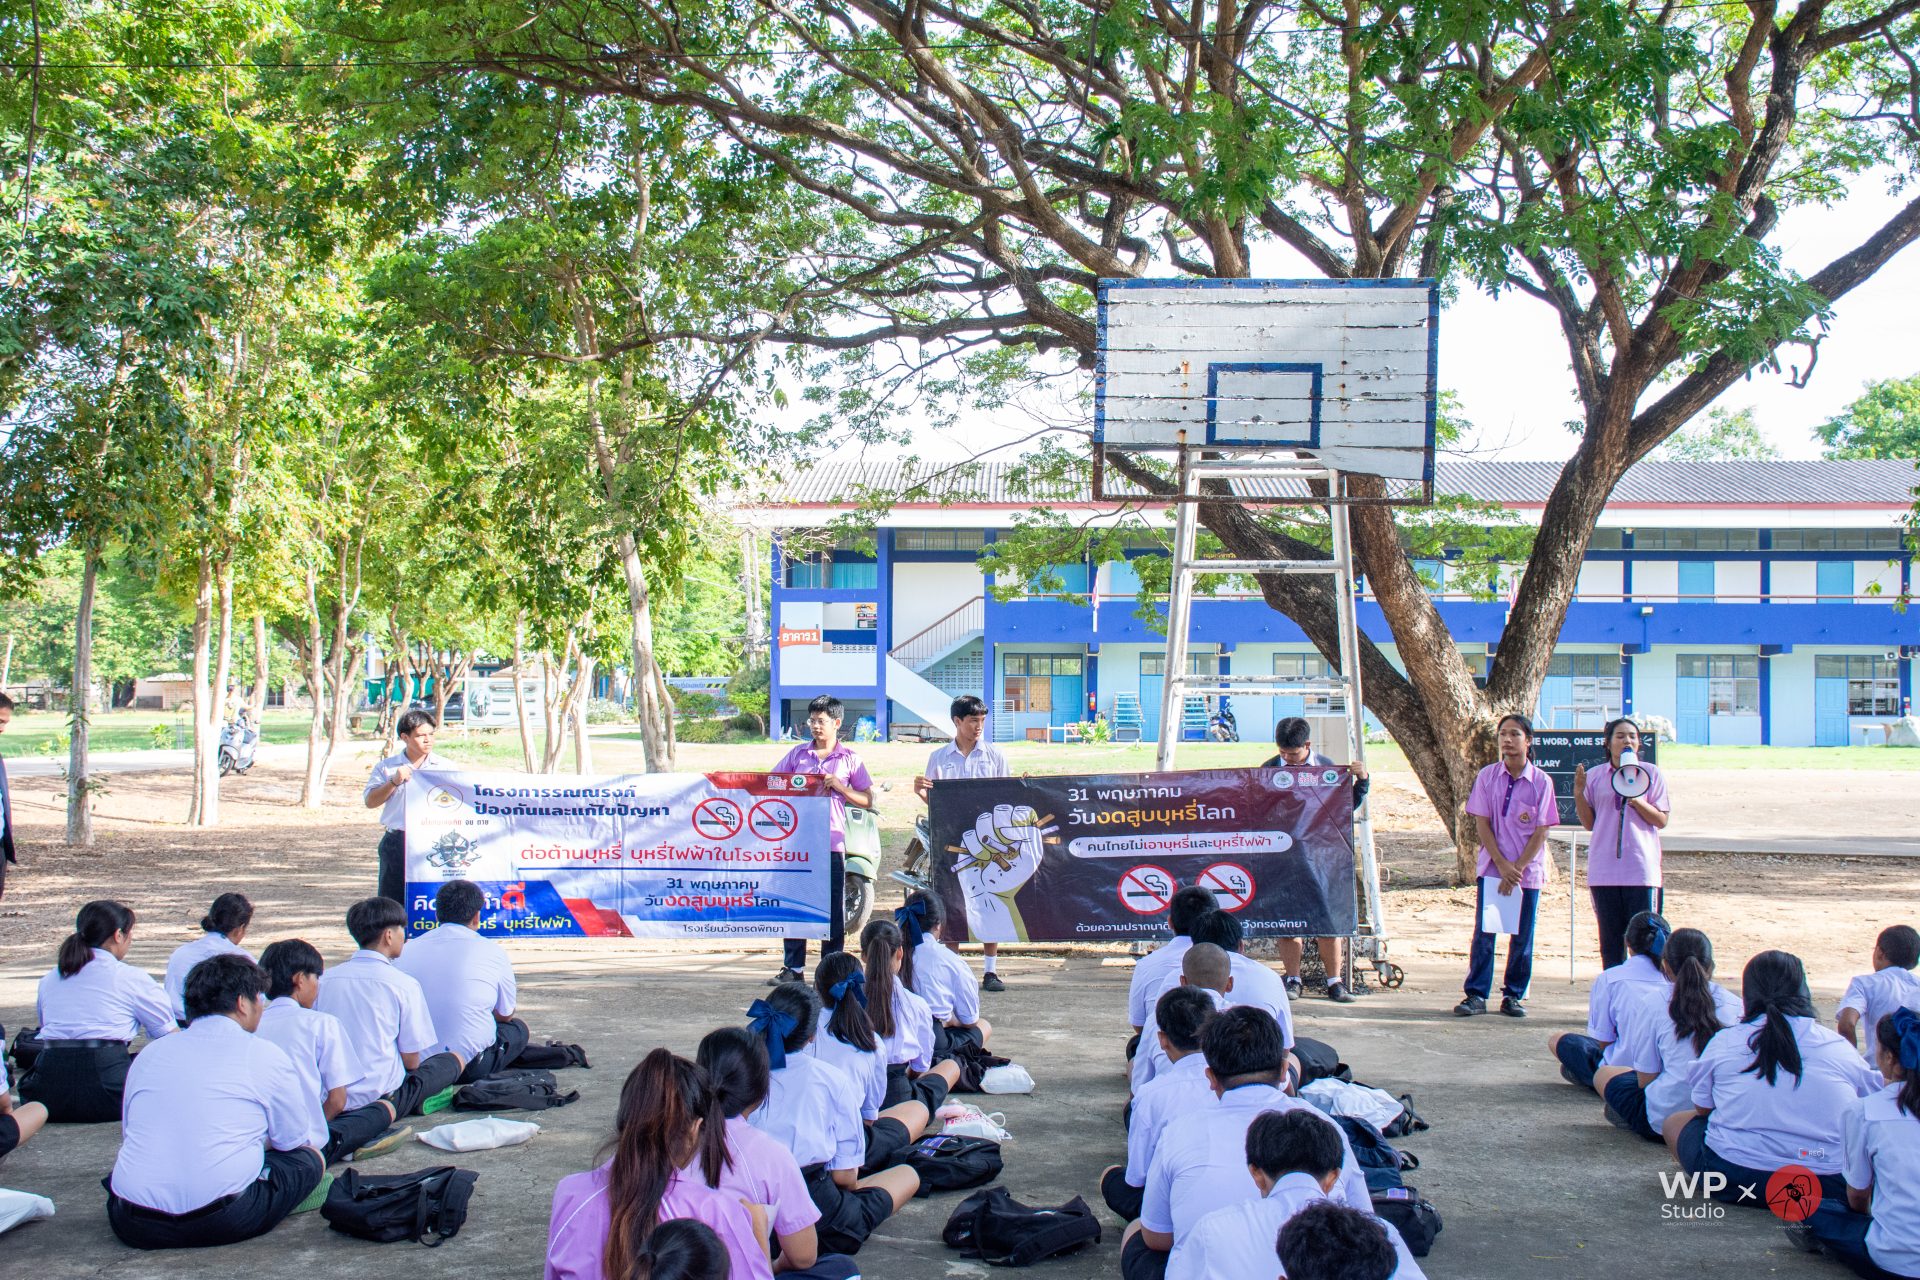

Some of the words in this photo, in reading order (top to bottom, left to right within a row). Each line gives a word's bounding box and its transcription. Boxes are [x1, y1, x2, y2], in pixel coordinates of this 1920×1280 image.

[1542, 737, 1572, 747] WORD,
[1573, 737, 1592, 746] ONE
[1533, 759, 1561, 768] ULARY
[1067, 788, 1089, 802] 31
[1096, 786, 1182, 803] พฤษภาคม
[474, 800, 671, 818] ป้องกันและแก้ไขปัญหา
[1068, 798, 1236, 828] วันงดสูบบุหรี่โลก
[520, 841, 622, 864] ต่อต้านบุหรี่
[630, 840, 809, 864] บุหรี่ไฟฟ้าในโรงเรียน
[1087, 833, 1272, 854] คนไทยไม่เอาบุหรี่และบุหรี่ไฟฟ้า
[666, 877, 683, 889] 31
[690, 879, 760, 891] พฤษภาคม
[644, 886, 780, 912] วันงดสูบบุหรี่โลก
[503, 912, 572, 932] บุหรี่ไฟฟ้า
[682, 923, 785, 934] โรงเรียนวังกรดพิทยา
[1240, 918, 1308, 929] วังกรดพิทยา
